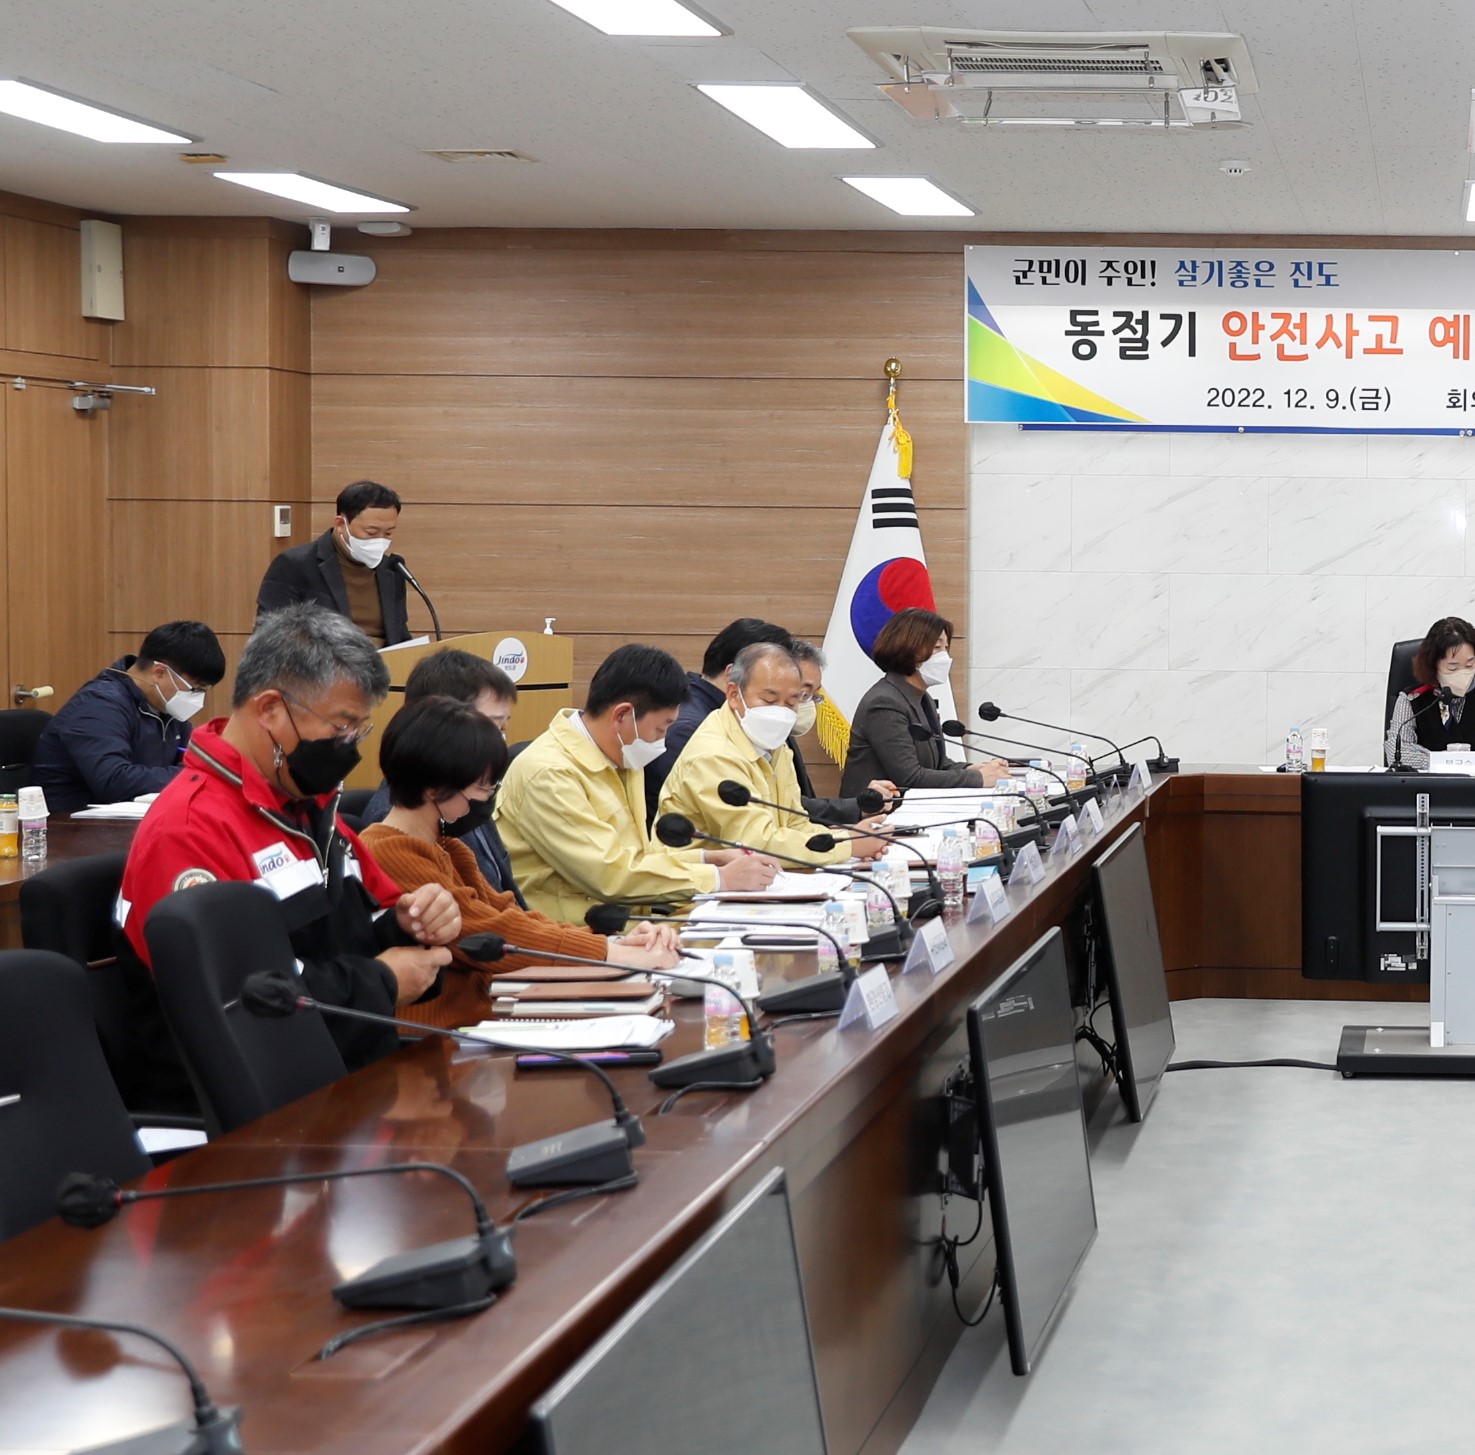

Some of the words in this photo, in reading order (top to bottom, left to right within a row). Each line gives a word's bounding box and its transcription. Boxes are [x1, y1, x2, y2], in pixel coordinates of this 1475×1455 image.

[1012, 258, 1087, 286] 군민이
[1097, 259, 1157, 287] 주인!
[1174, 259, 1277, 289] 살기좋은
[1289, 260, 1340, 289] 진도
[1064, 309, 1197, 361] 동절기
[1222, 311, 1404, 362] 안전사고
[1206, 387, 1273, 410] 2022.
[1283, 388, 1315, 410] 12.
[1325, 385, 1392, 413] 9.(금)
[496, 655, 520, 665] Jindo
